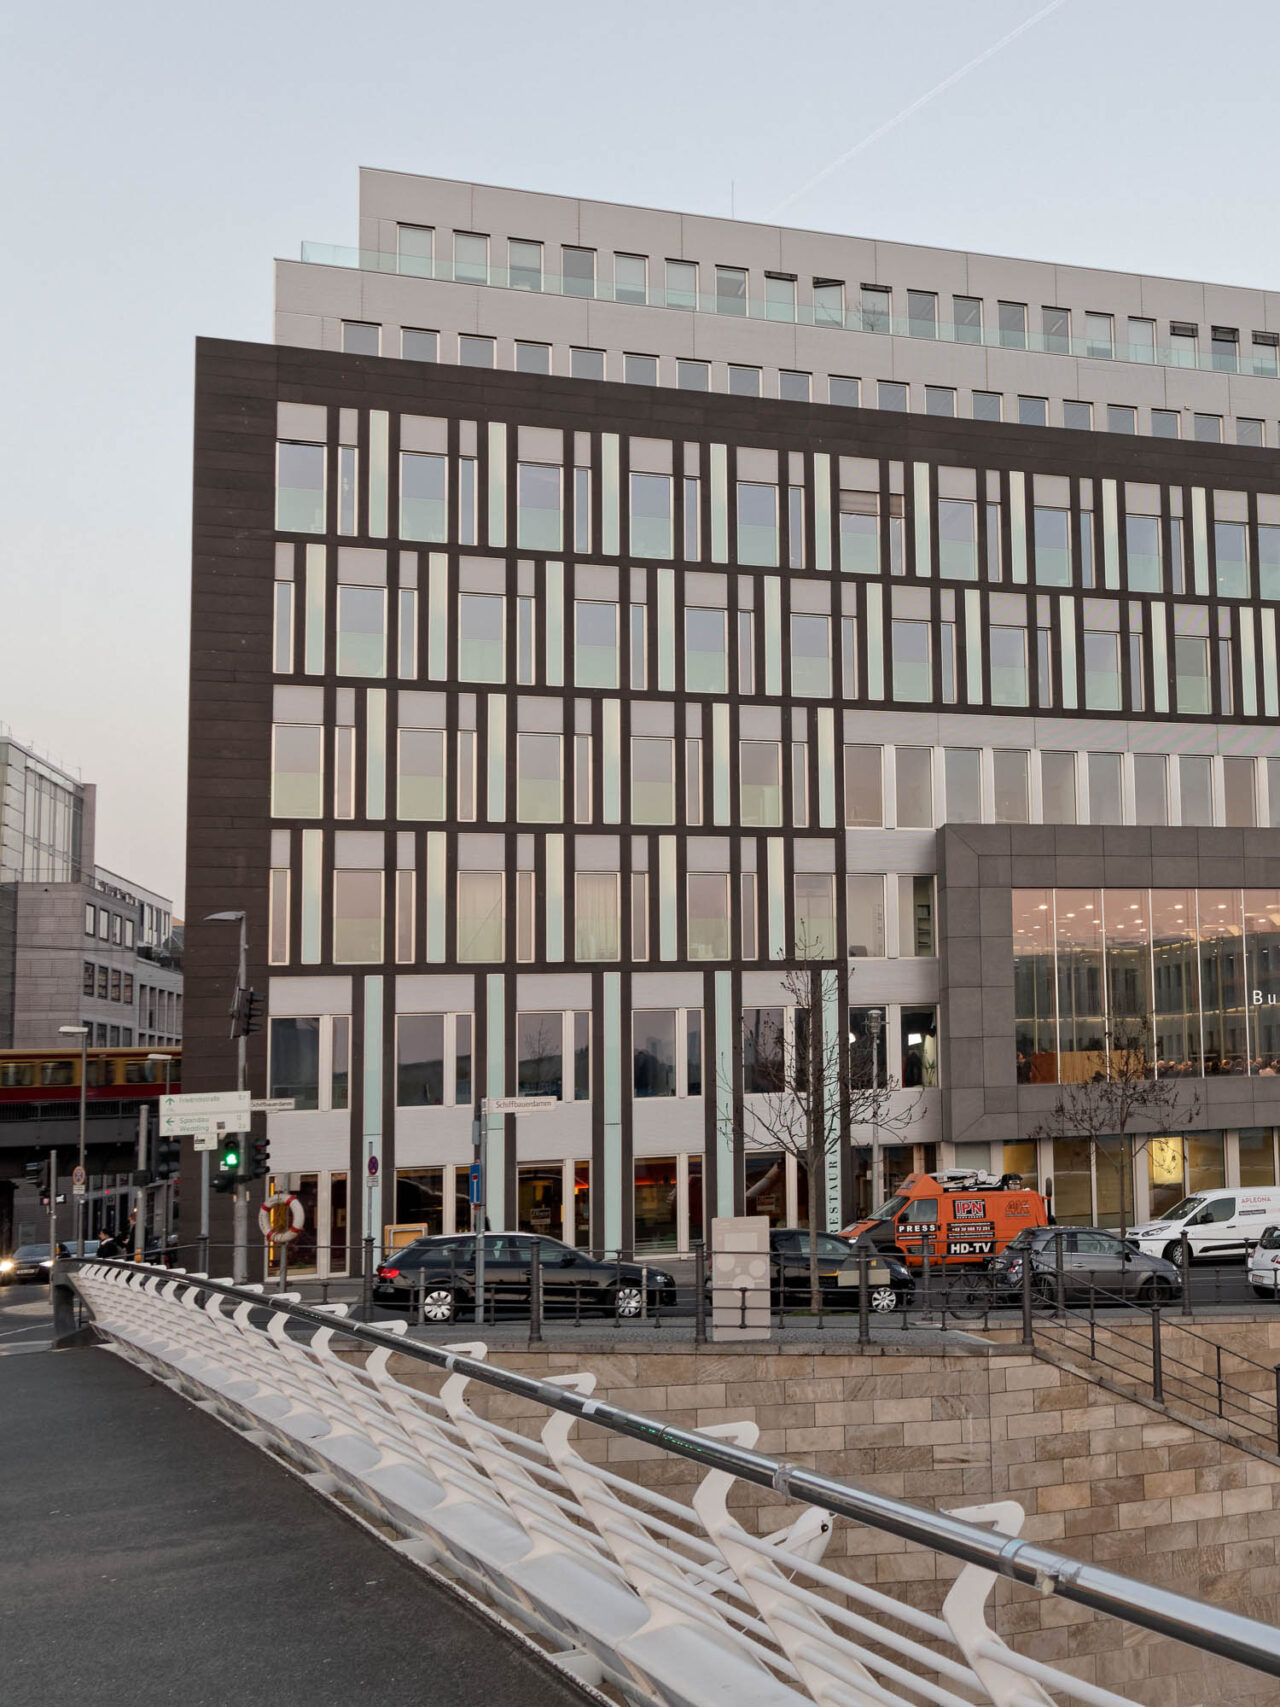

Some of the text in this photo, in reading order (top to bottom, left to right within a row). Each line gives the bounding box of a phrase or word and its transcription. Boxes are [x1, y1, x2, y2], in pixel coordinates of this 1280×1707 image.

[495, 1100, 552, 1109] Schiffbauerdamm
[956, 1201, 984, 1215] IPN
[898, 1224, 936, 1233] PRESS
[951, 1242, 991, 1254] HD-TV
